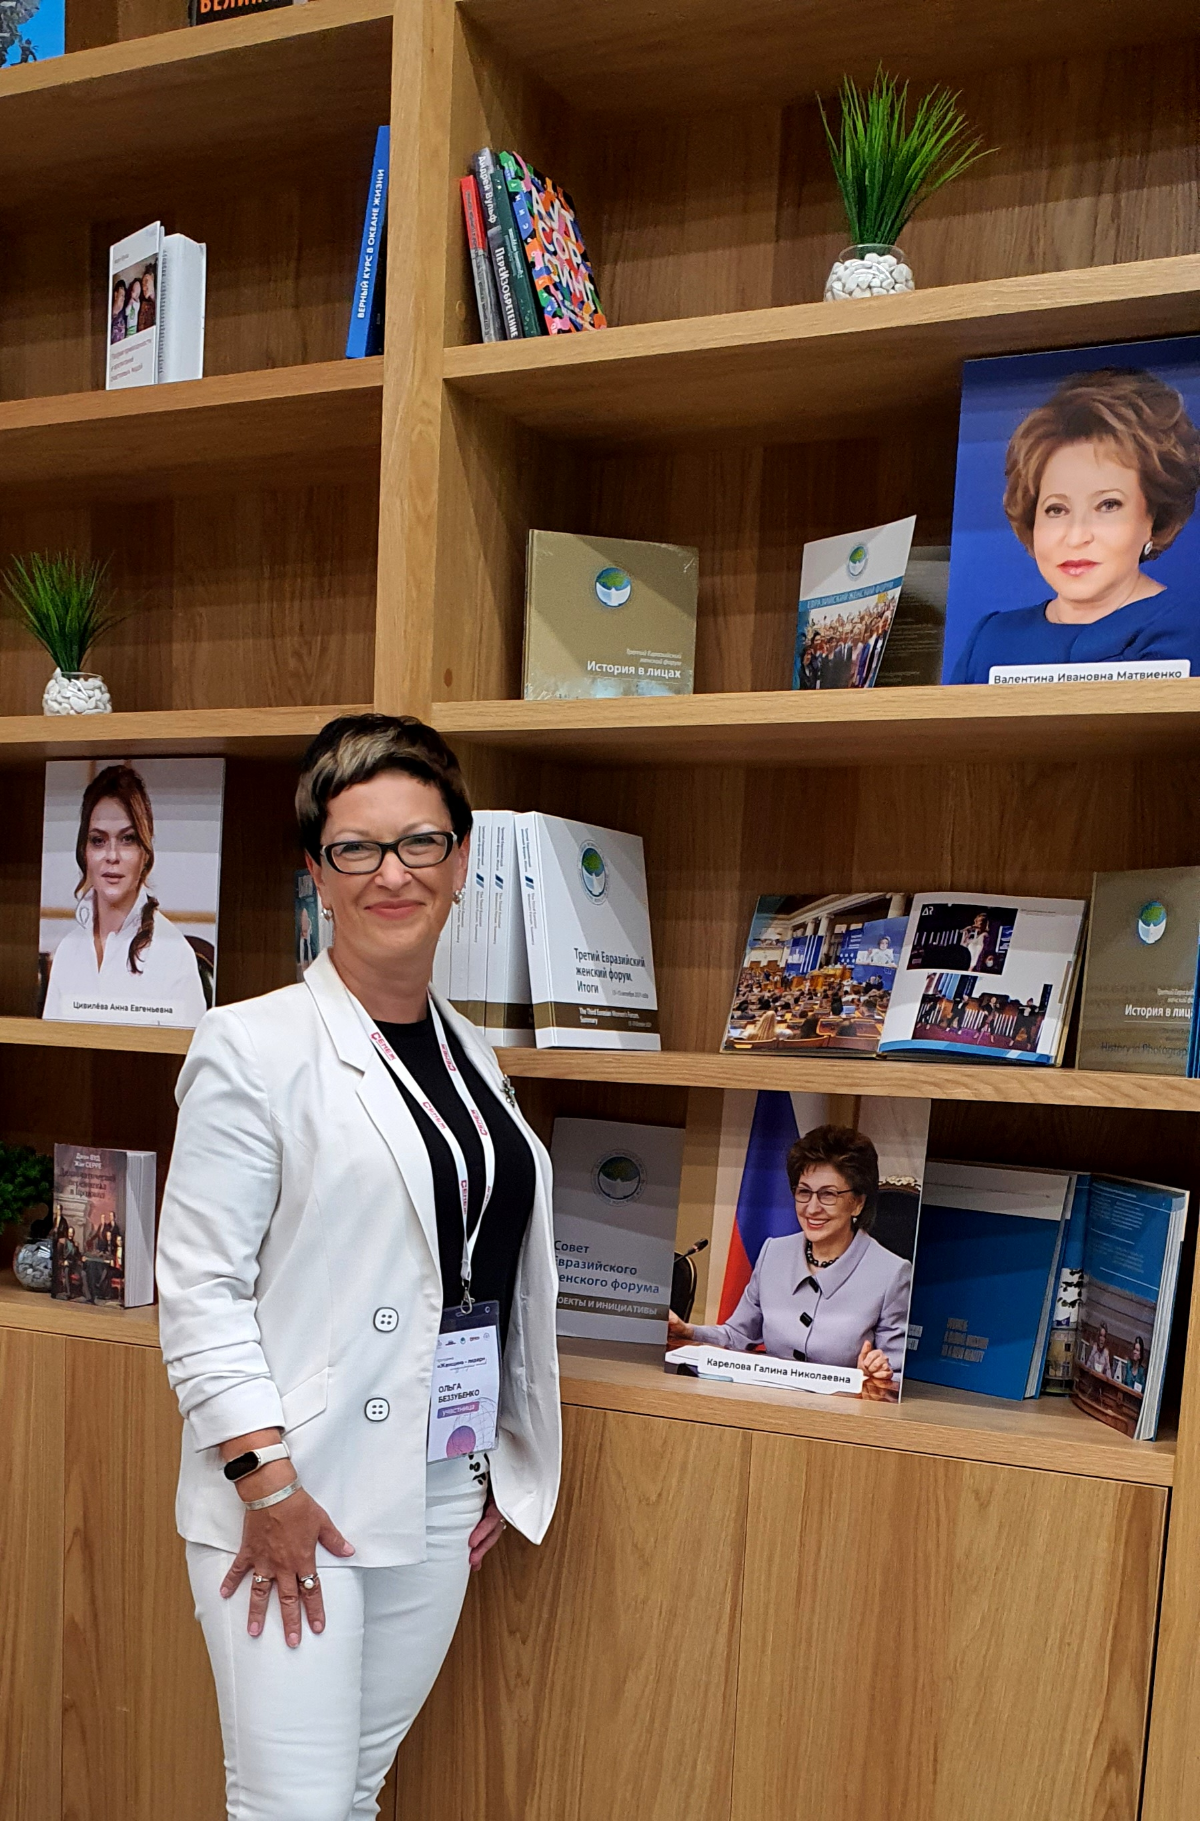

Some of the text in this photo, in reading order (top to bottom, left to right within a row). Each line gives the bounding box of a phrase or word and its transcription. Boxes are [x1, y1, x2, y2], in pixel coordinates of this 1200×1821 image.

[372, 169, 385, 206] ЖИЗНИ
[477, 156, 492, 190] Андрей
[485, 190, 498, 224] Вульф
[368, 208, 380, 246] ОКЕАНЕ
[364, 255, 372, 279] КУРС
[357, 281, 368, 318] ВЕРНЫЙ
[494, 247, 519, 338] ПЕРЕИЗОБРЕТЕНИЕ
[587, 660, 635, 676] История
[646, 668, 682, 679] лицах
[994, 670, 1182, 684] Валентина Ивановна Матвиенко
[574, 948, 646, 968] Третий Евразийский
[576, 966, 633, 983] женский форум.
[576, 980, 599, 993] Итоги
[110, 1003, 128, 1012] Анна
[130, 1004, 173, 1014] Евгеньевна
[1125, 1004, 1163, 1018] История
[1166, 1008, 1171, 1017] в
[1142, 1043, 1188, 1059] Photograp
[555, 1240, 590, 1254] Совет
[559, 1272, 660, 1294] енского форума
[557, 1296, 587, 1307] ОЕКТЫ
[596, 1301, 657, 1316] ИНИЦИАТИВЫ
[706, 1358, 851, 1384] Карелова Галина Николаевна
[438, 1383, 462, 1393] ОЛЬГА
[438, 1389, 480, 1403] БЕЗЗУБЕНКО
